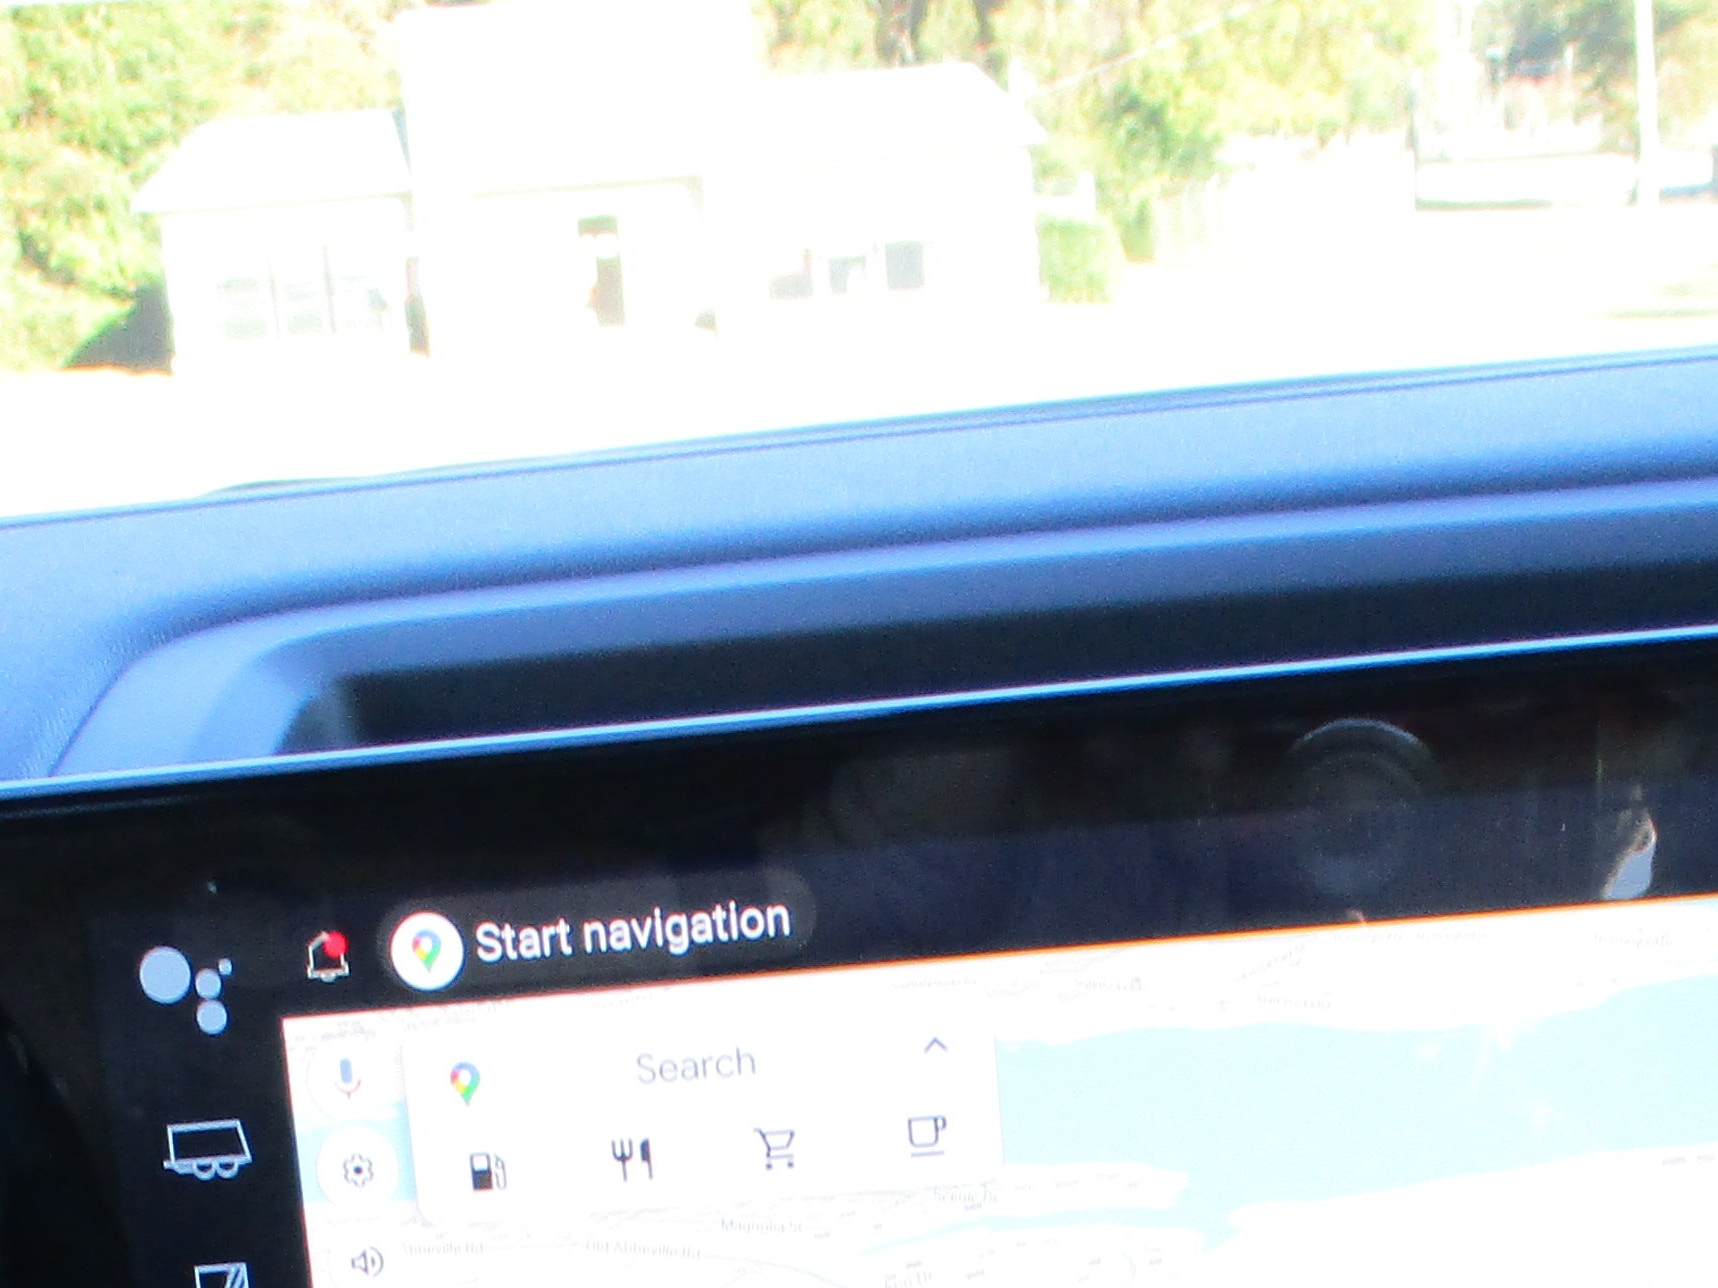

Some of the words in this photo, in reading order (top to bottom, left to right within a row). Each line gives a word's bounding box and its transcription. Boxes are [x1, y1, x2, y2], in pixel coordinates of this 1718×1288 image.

[476, 917, 573, 962] Start
[583, 901, 790, 955] navigation
[636, 1046, 758, 1086] Search
